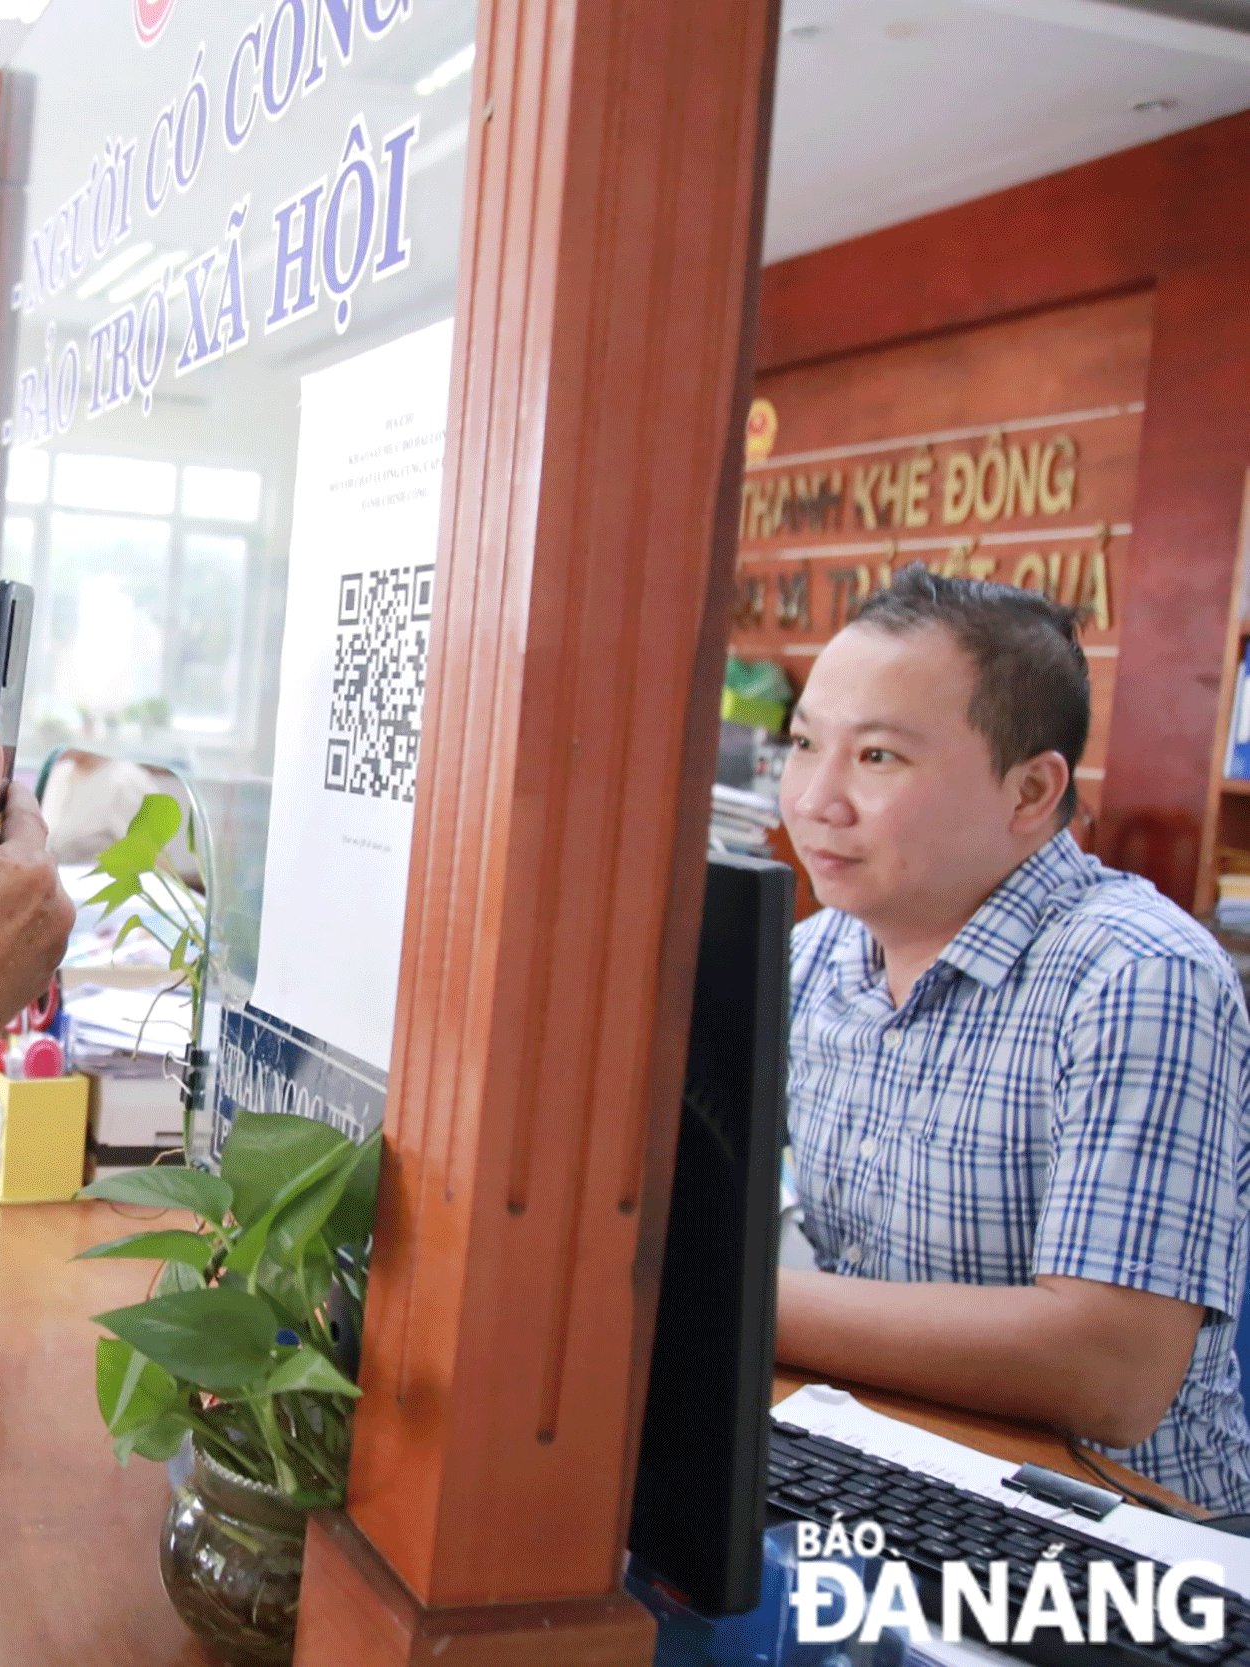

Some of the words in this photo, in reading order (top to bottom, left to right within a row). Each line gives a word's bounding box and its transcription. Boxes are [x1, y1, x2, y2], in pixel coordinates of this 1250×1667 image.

[145, 43, 208, 216] CÓ
[88, 266, 173, 416] TRỢ
[176, 195, 249, 377] XÃ
[264, 112, 421, 335] HỘI
[942, 427, 1078, 525] ĐÔNG
